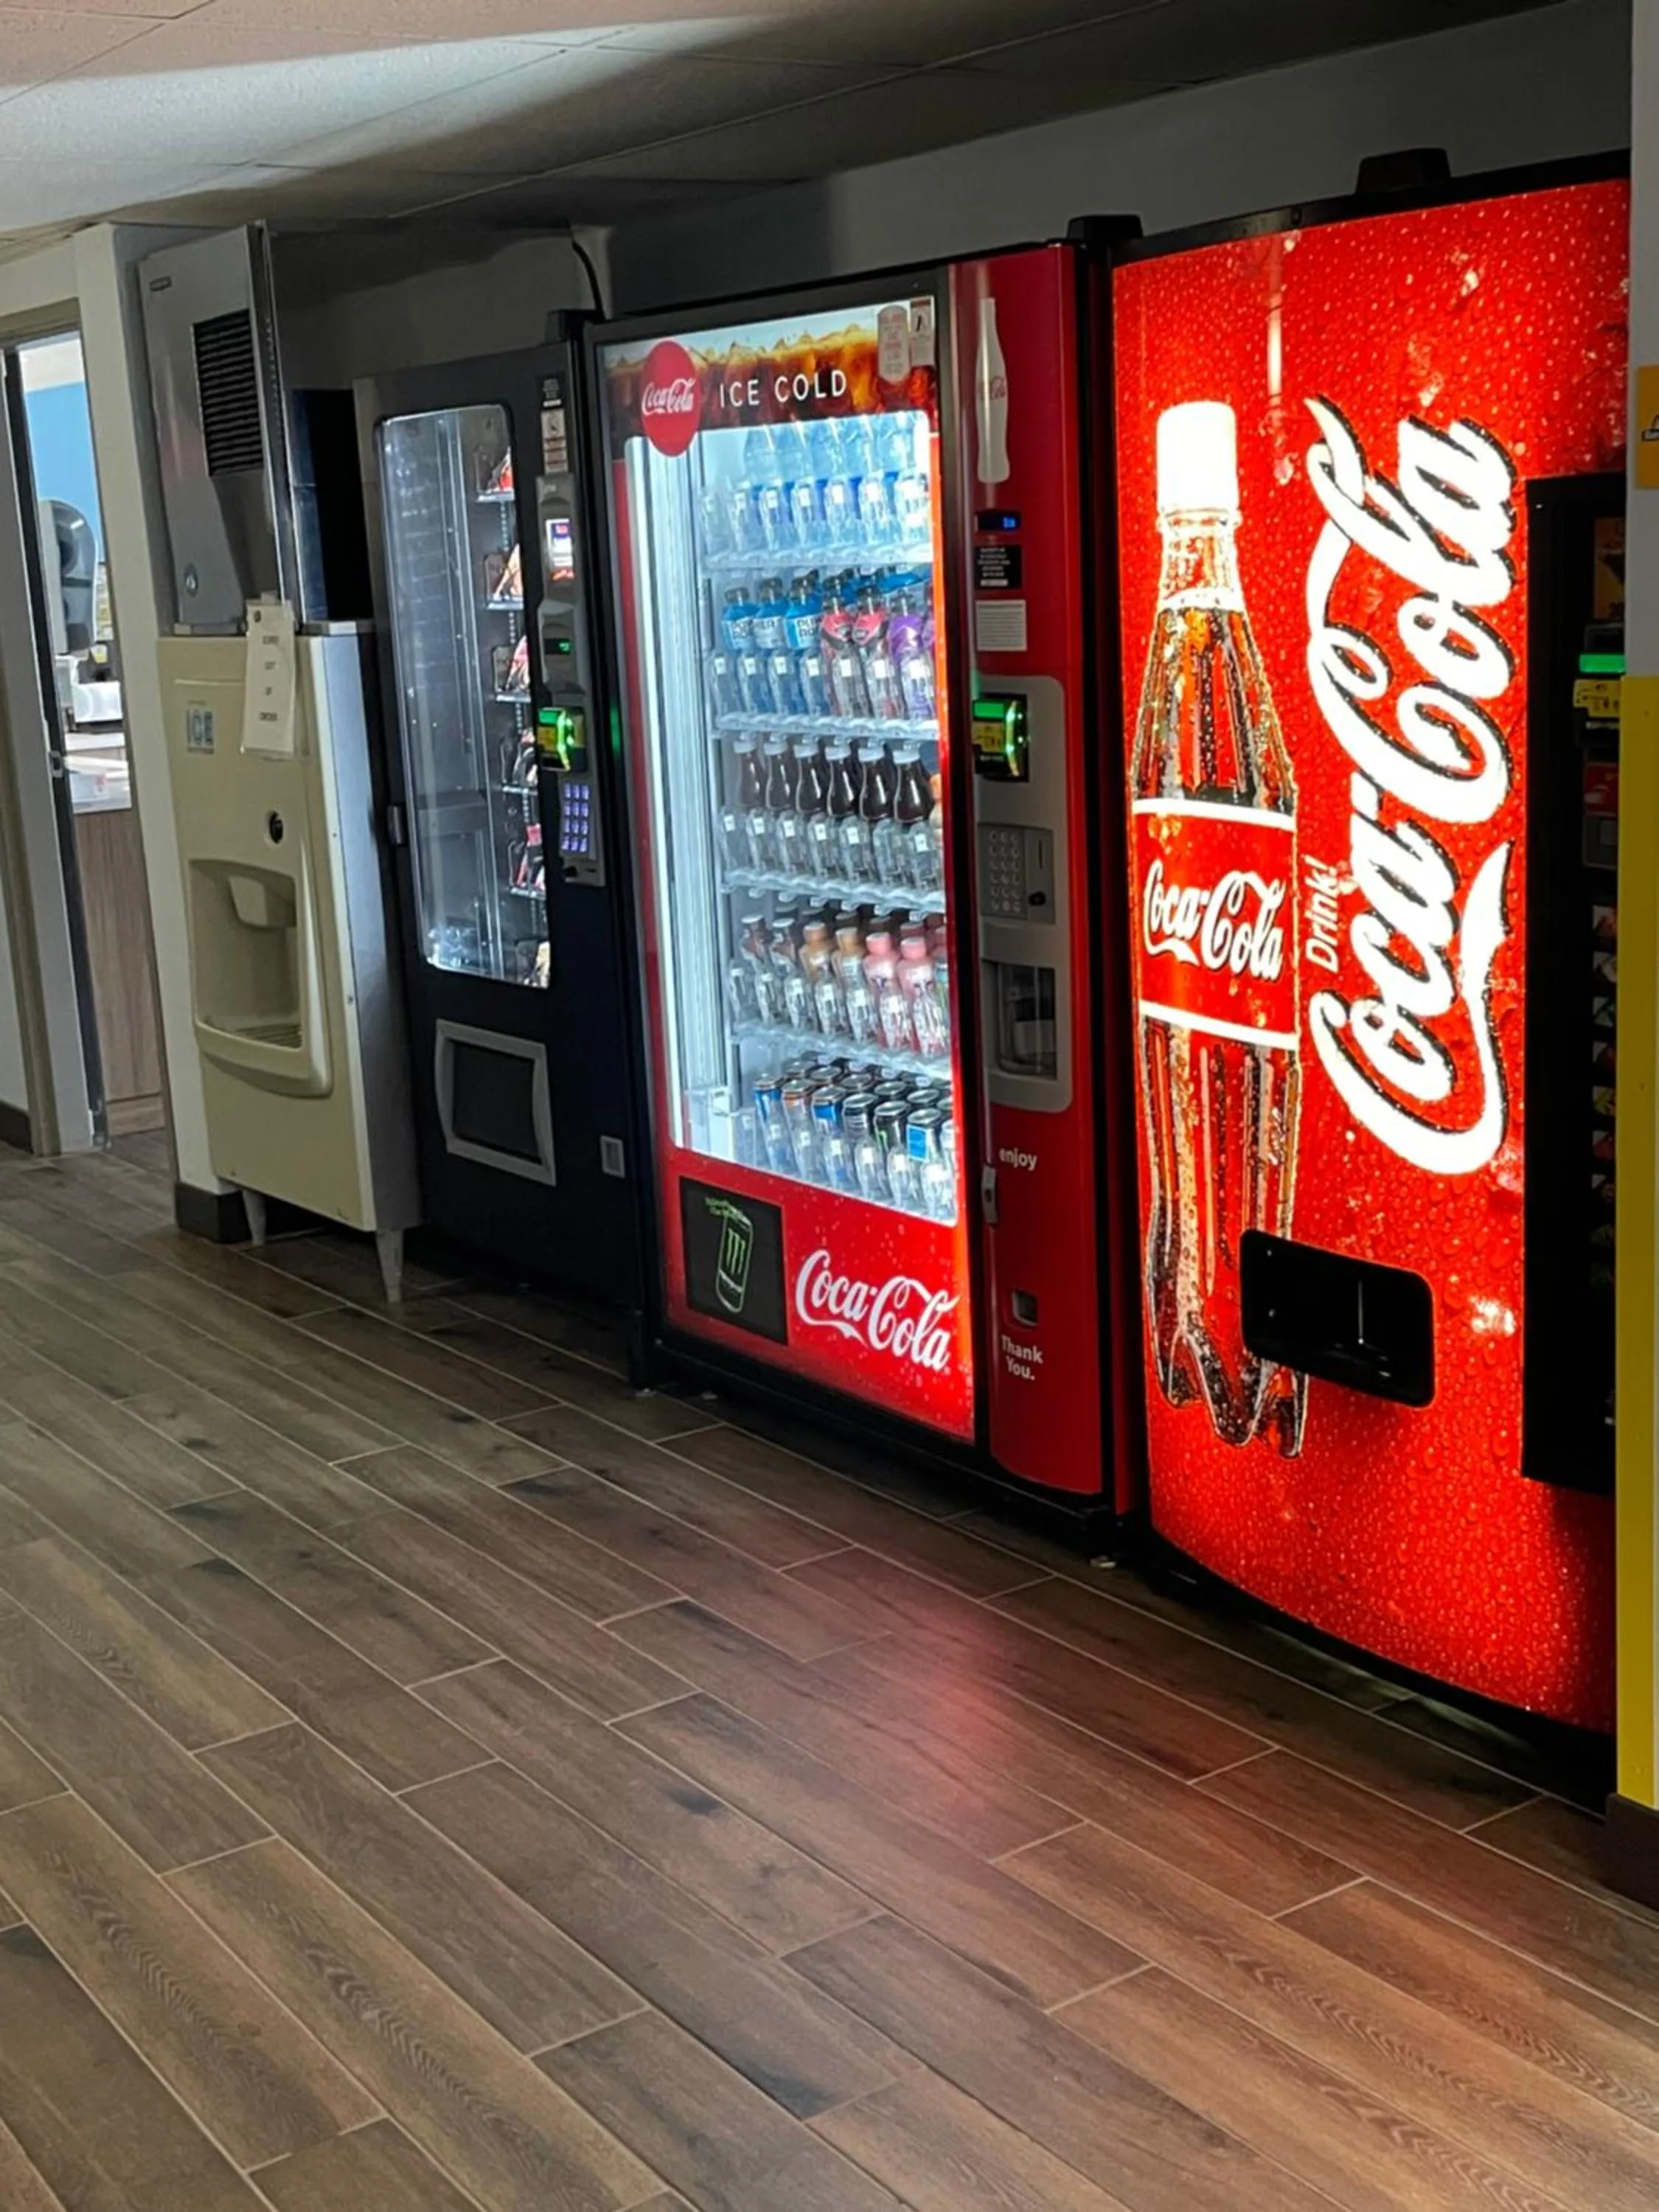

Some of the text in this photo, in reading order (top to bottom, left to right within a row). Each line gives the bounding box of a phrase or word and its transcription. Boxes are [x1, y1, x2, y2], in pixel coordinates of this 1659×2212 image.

[720, 369, 847, 408] ICE COLD
[1304, 392, 1517, 1176] Coca-Cola
[1144, 858, 1287, 981] Coca-Cola
[1304, 853, 1339, 974] Drink!
[999, 1147, 1037, 1172] enjoy
[796, 1250, 960, 1370] Coca-Cola
[1001, 1334, 1043, 1364] Thank
[1005, 1355, 1035, 1381] You.
